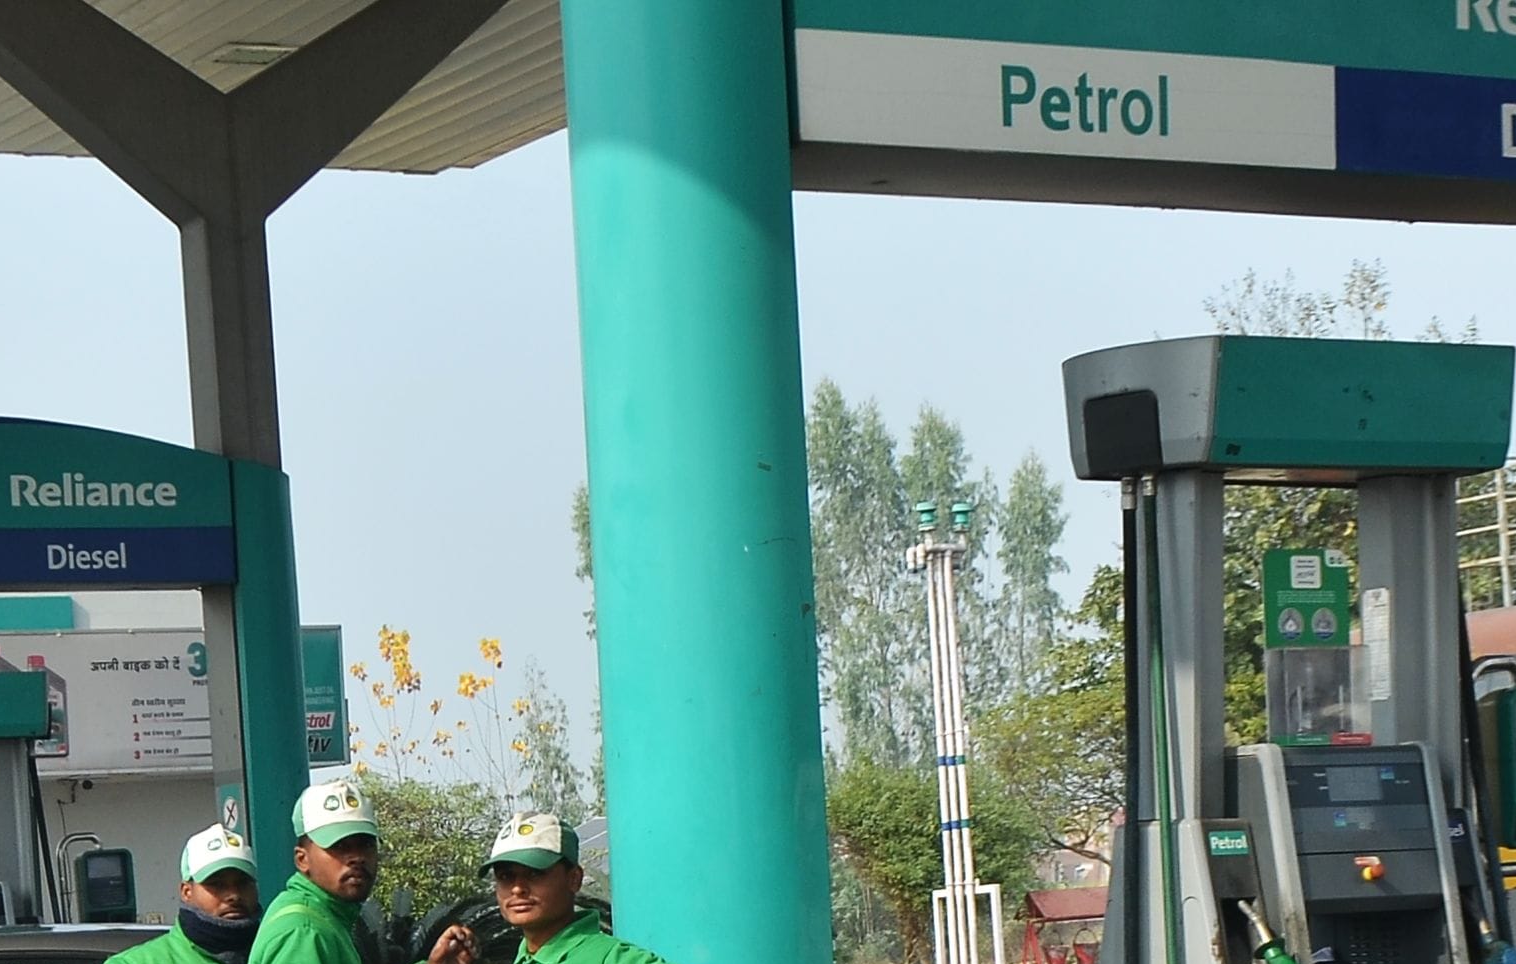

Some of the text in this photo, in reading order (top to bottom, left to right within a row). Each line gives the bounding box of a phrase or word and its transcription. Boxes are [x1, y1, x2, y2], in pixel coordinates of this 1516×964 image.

[1001, 64, 1170, 137] Petrol
[9, 472, 178, 507] Reliance
[46, 542, 128, 570] Diesel
[1210, 835, 1248, 850] Petrol
